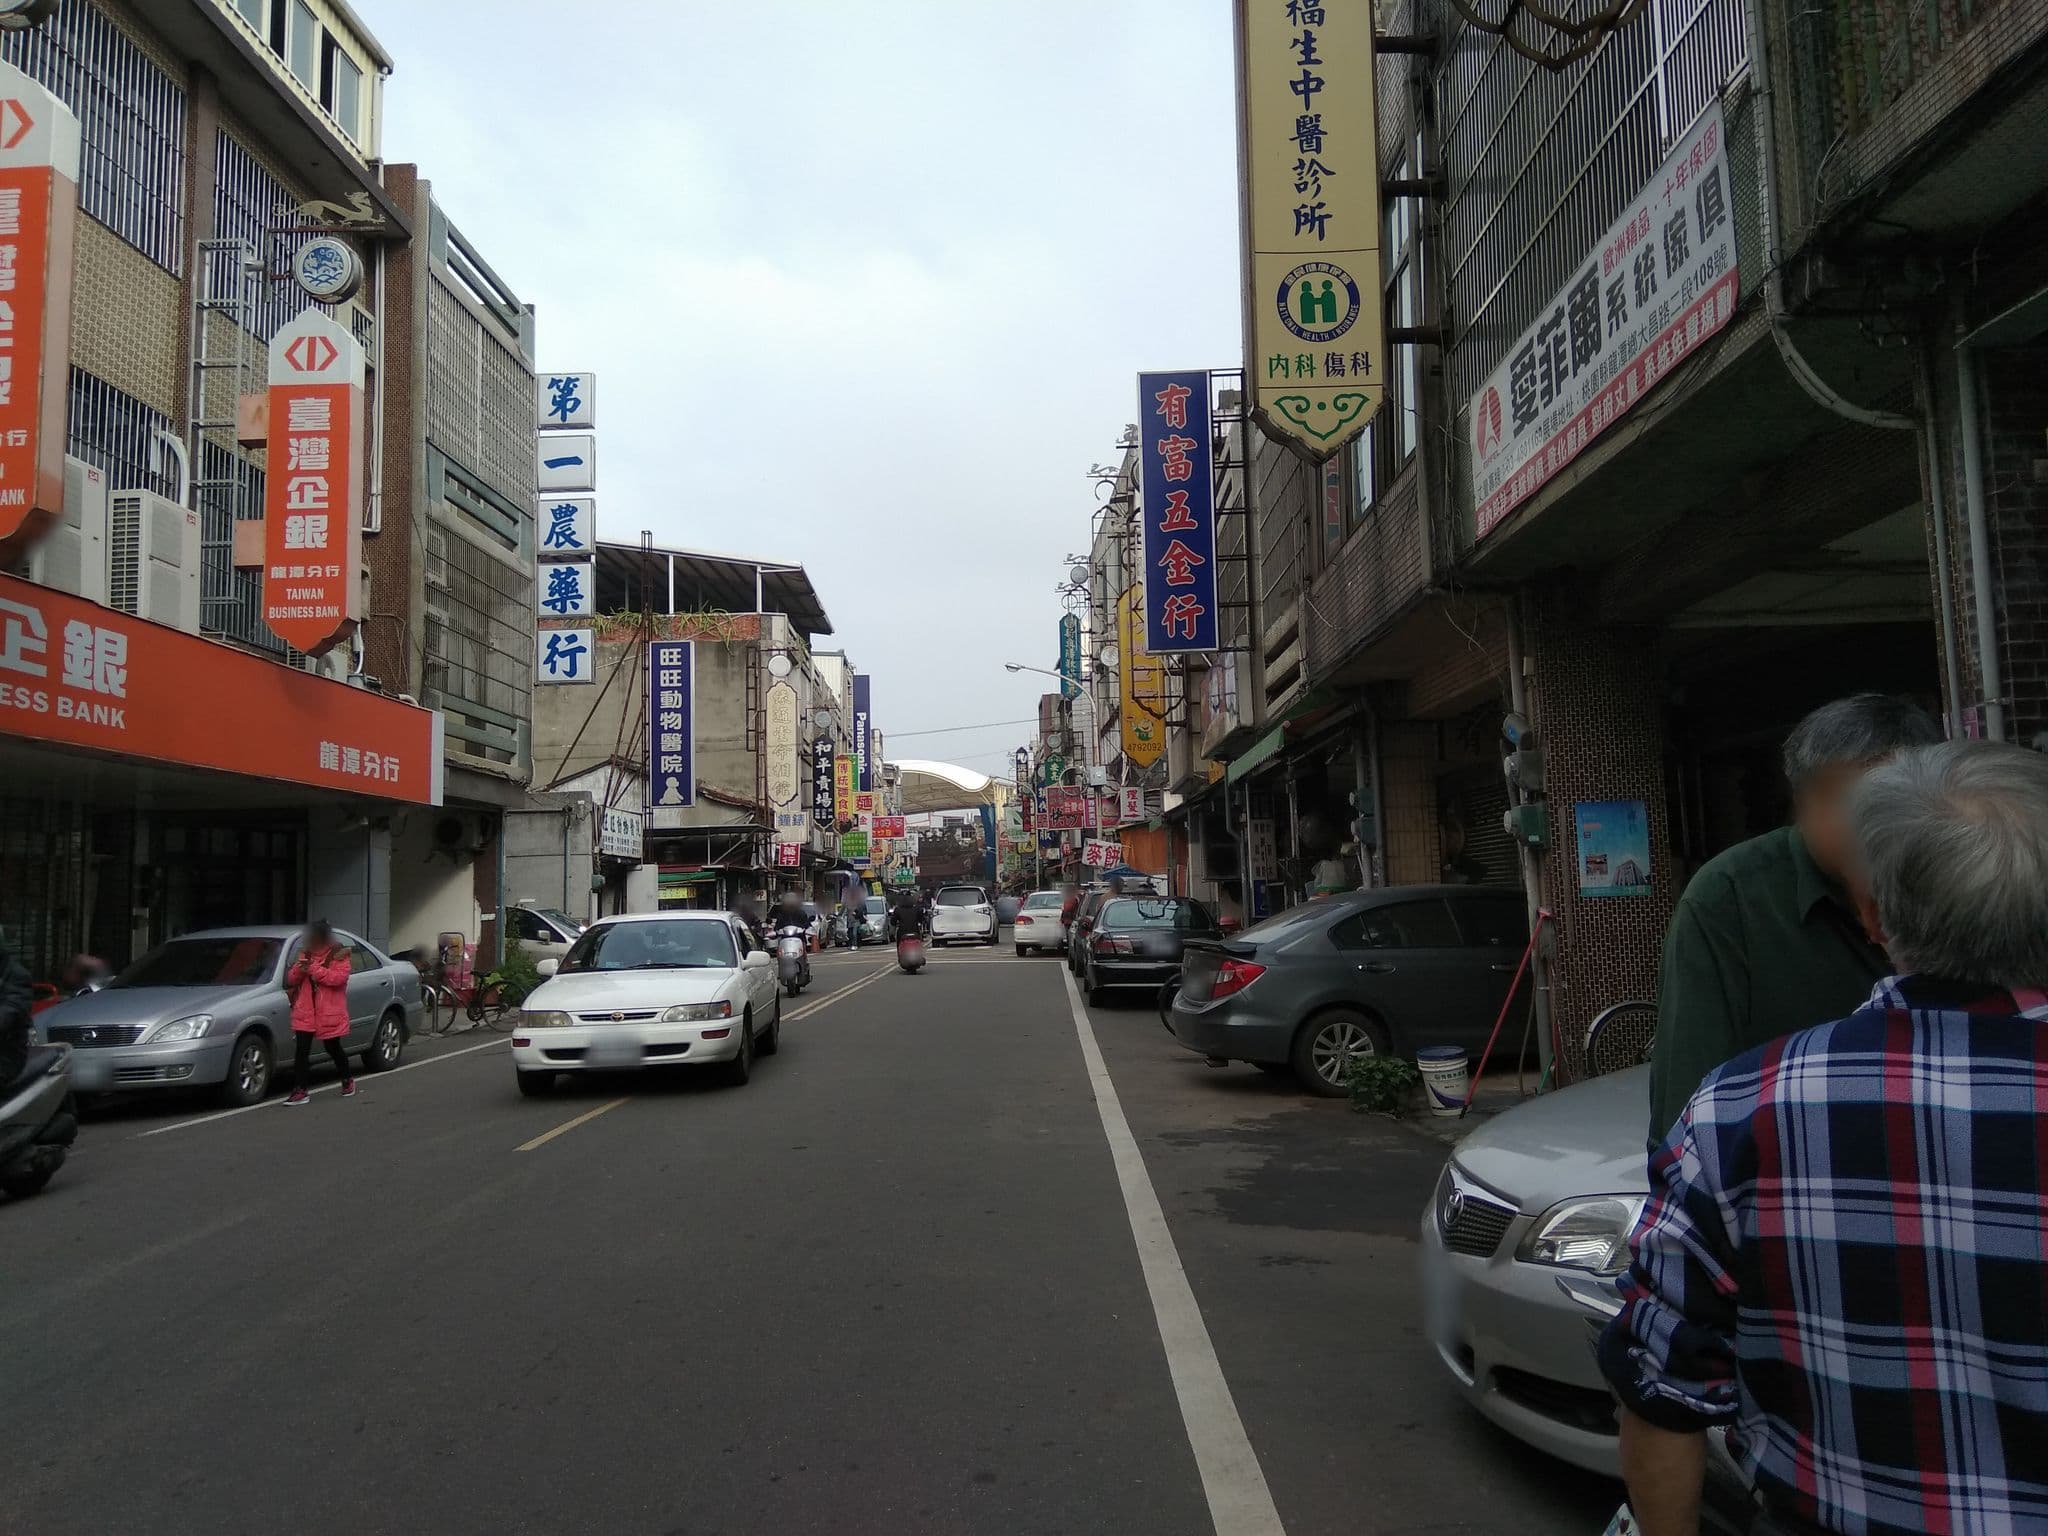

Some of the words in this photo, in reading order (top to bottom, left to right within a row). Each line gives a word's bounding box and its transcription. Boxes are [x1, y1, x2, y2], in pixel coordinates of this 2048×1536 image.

[1285, 0, 1336, 241] 福生中醫診所
[285, 397, 332, 550] 臺灣企銀
[541, 376, 588, 679] 第一農藥行
[1155, 383, 1206, 640] 有富五金行
[271, 565, 341, 579] 龍潭分行
[286, 587, 324, 600] TAIWAN
[269, 606, 314, 619] BUSINESS
[315, 605, 340, 618] BANK
[57, 696, 127, 730] BANK
[659, 648, 683, 775] 旺旺動物醫院
[856, 711, 868, 775] Panasonic
[319, 740, 401, 783] 龍潭分行
[814, 741, 833, 808] 和平賣場
